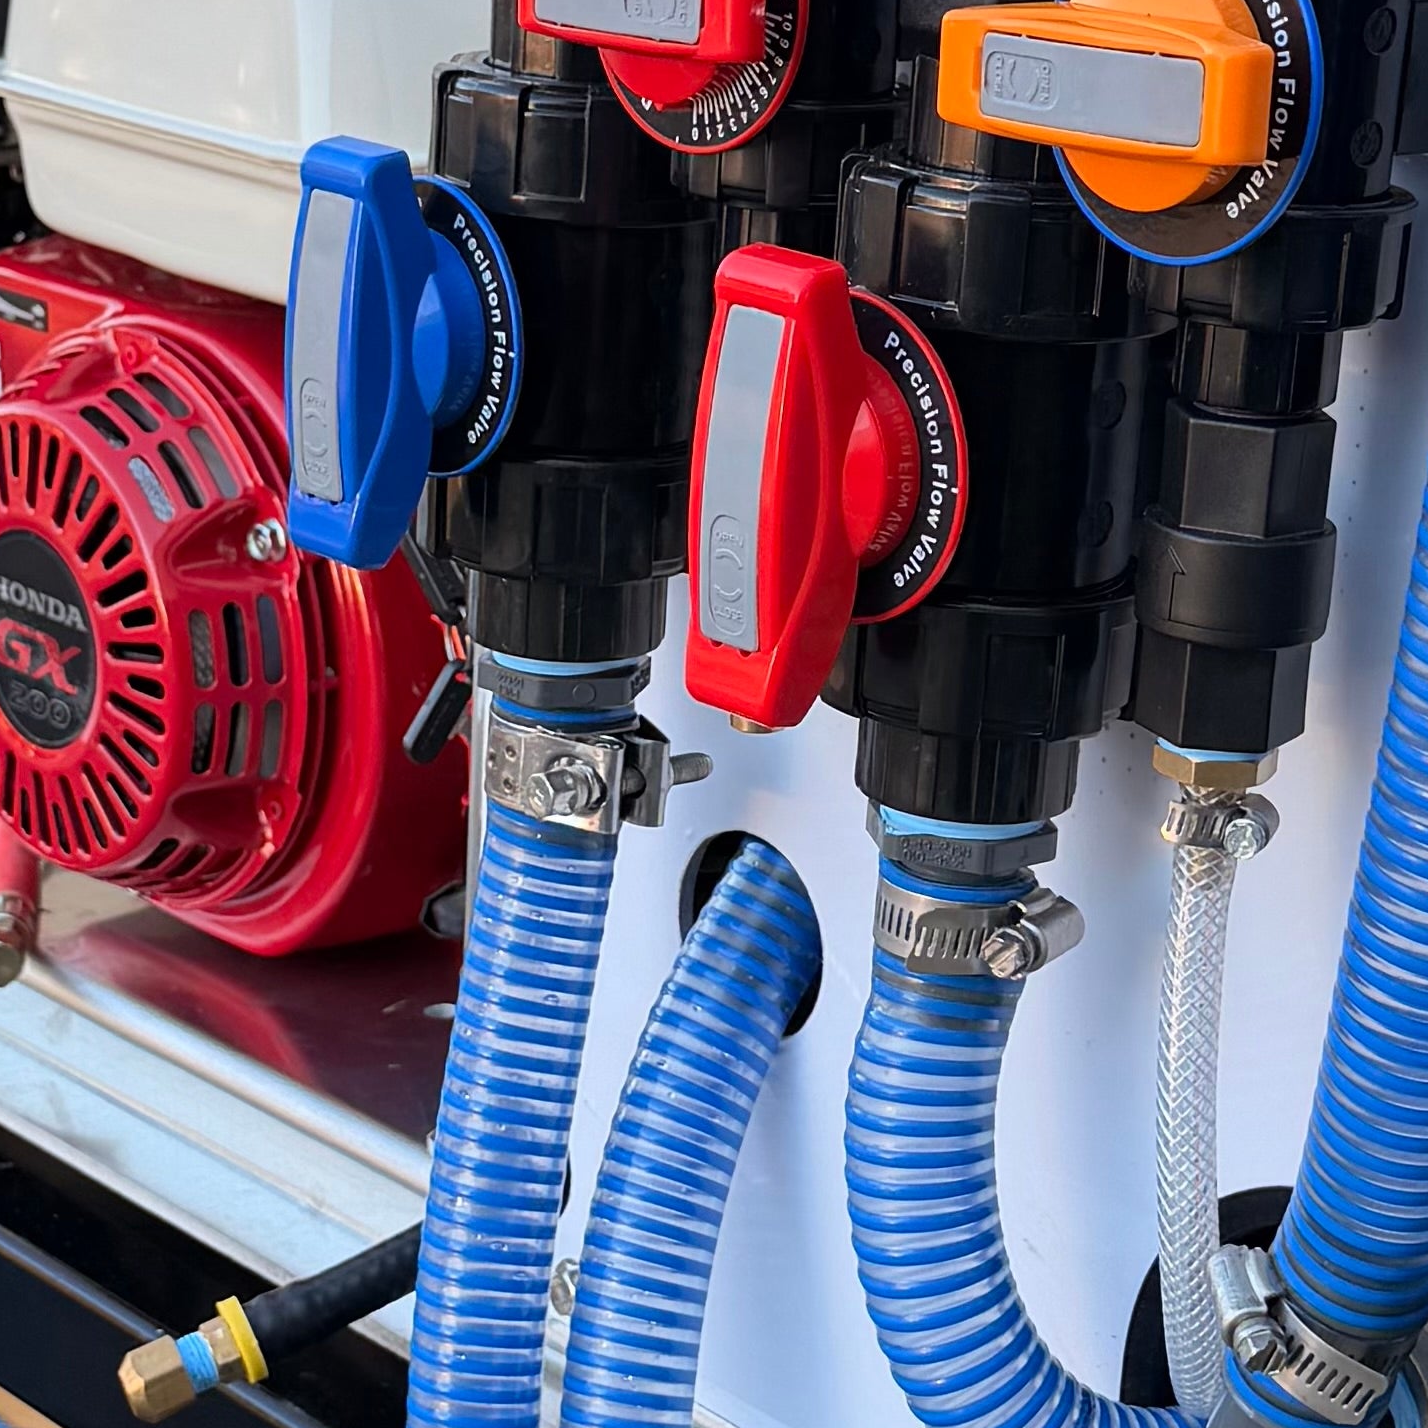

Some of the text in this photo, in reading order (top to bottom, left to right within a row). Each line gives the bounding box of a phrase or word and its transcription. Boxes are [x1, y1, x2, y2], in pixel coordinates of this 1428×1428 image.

[691, 127, 699, 141] 0
[716, 124, 725, 138] 2
[1268, 77, 1295, 152] Flow
[1225, 159, 1278, 219] Valve
[453, 213, 506, 444] Precision Flow Valve
[883, 331, 943, 454] Precision
[926, 463, 949, 529] Flow
[893, 534, 937, 588] Valve
[10, 681, 71, 729] 200
